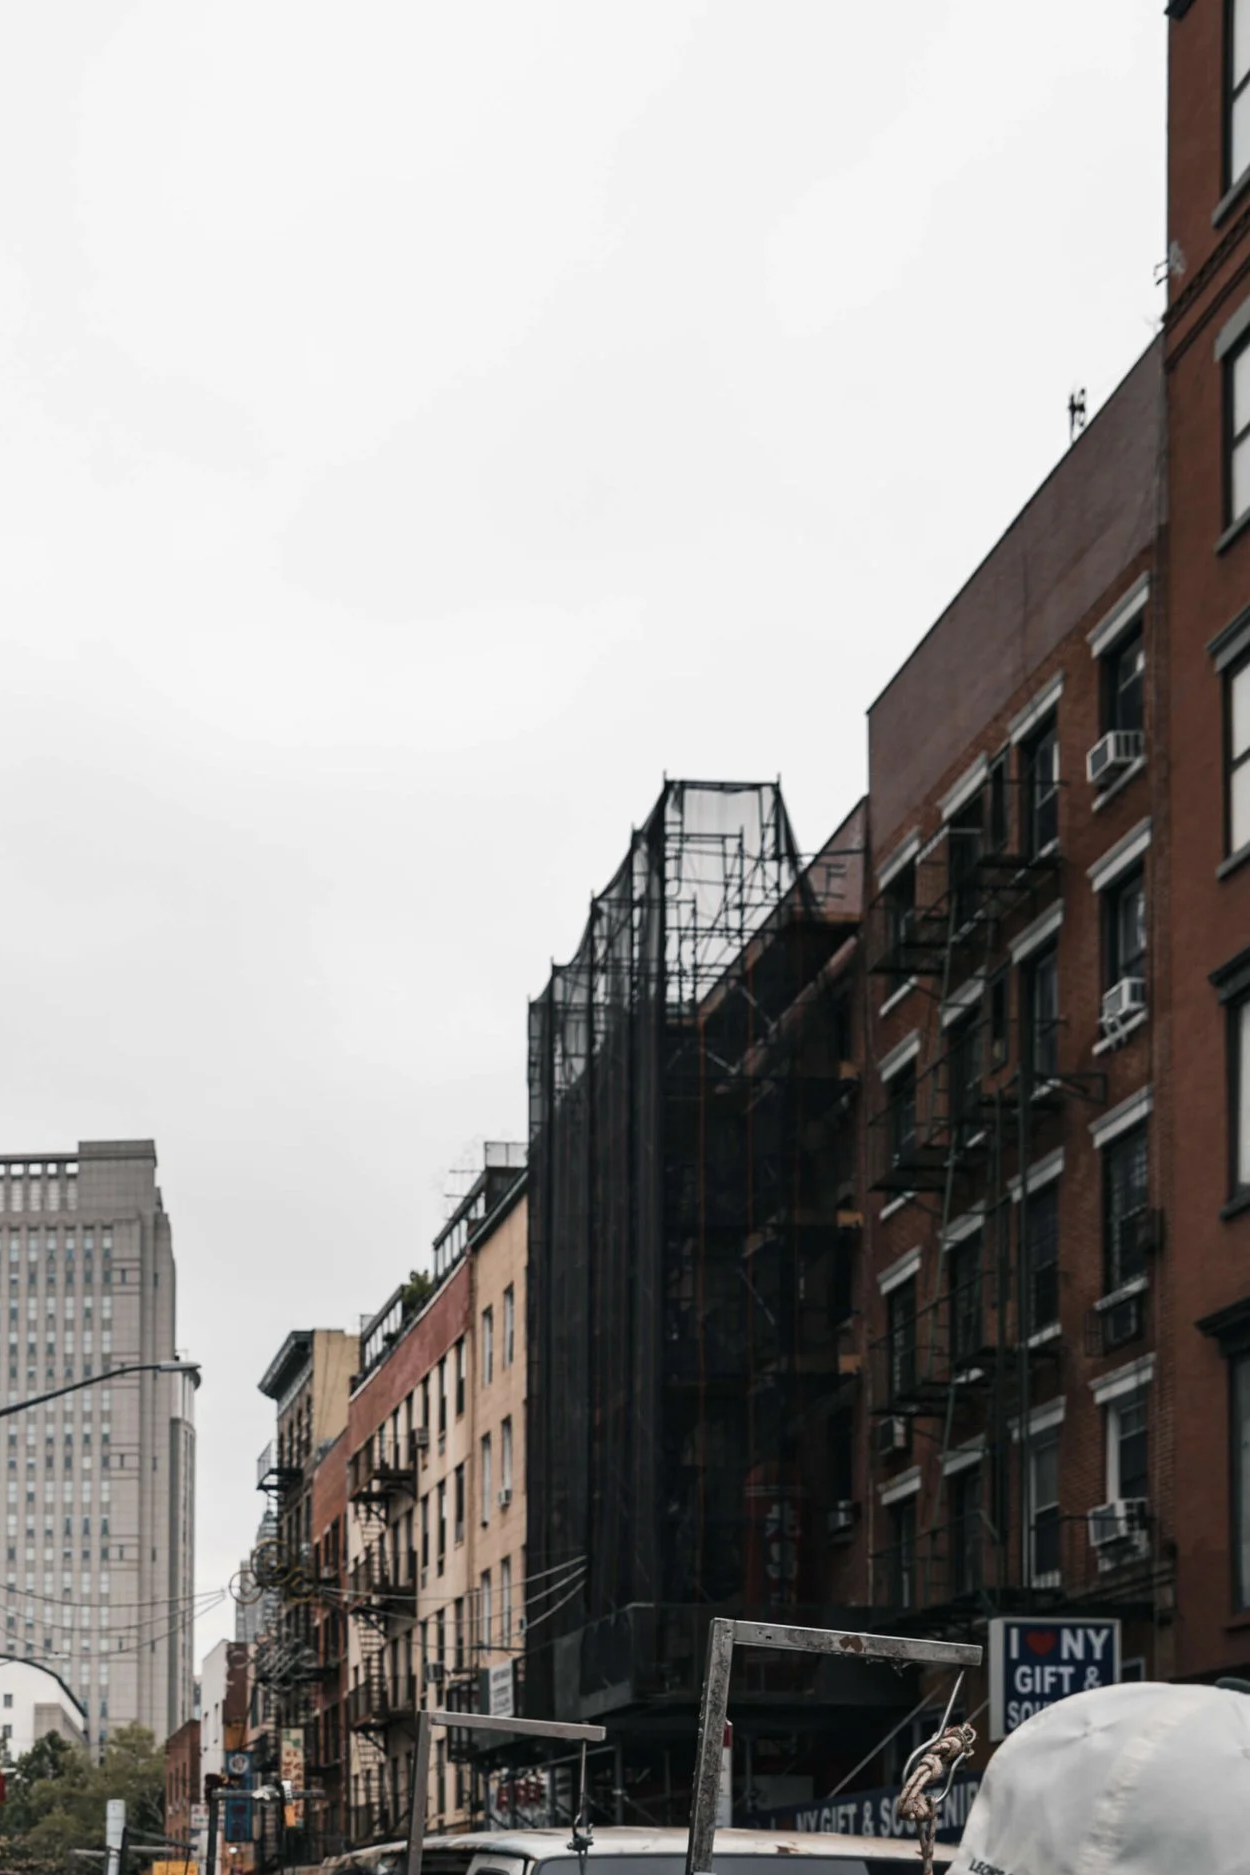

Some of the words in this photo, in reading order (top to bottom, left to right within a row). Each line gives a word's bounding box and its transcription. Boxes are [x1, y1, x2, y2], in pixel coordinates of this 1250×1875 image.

[1010, 1627, 1019, 1660] I
[1060, 1627, 1110, 1660] NY
[1014, 1665, 1075, 1694] GIFT
[1083, 1666, 1102, 1690] &
[820, 1803, 857, 1834] GIFT
[862, 1801, 875, 1836] &
